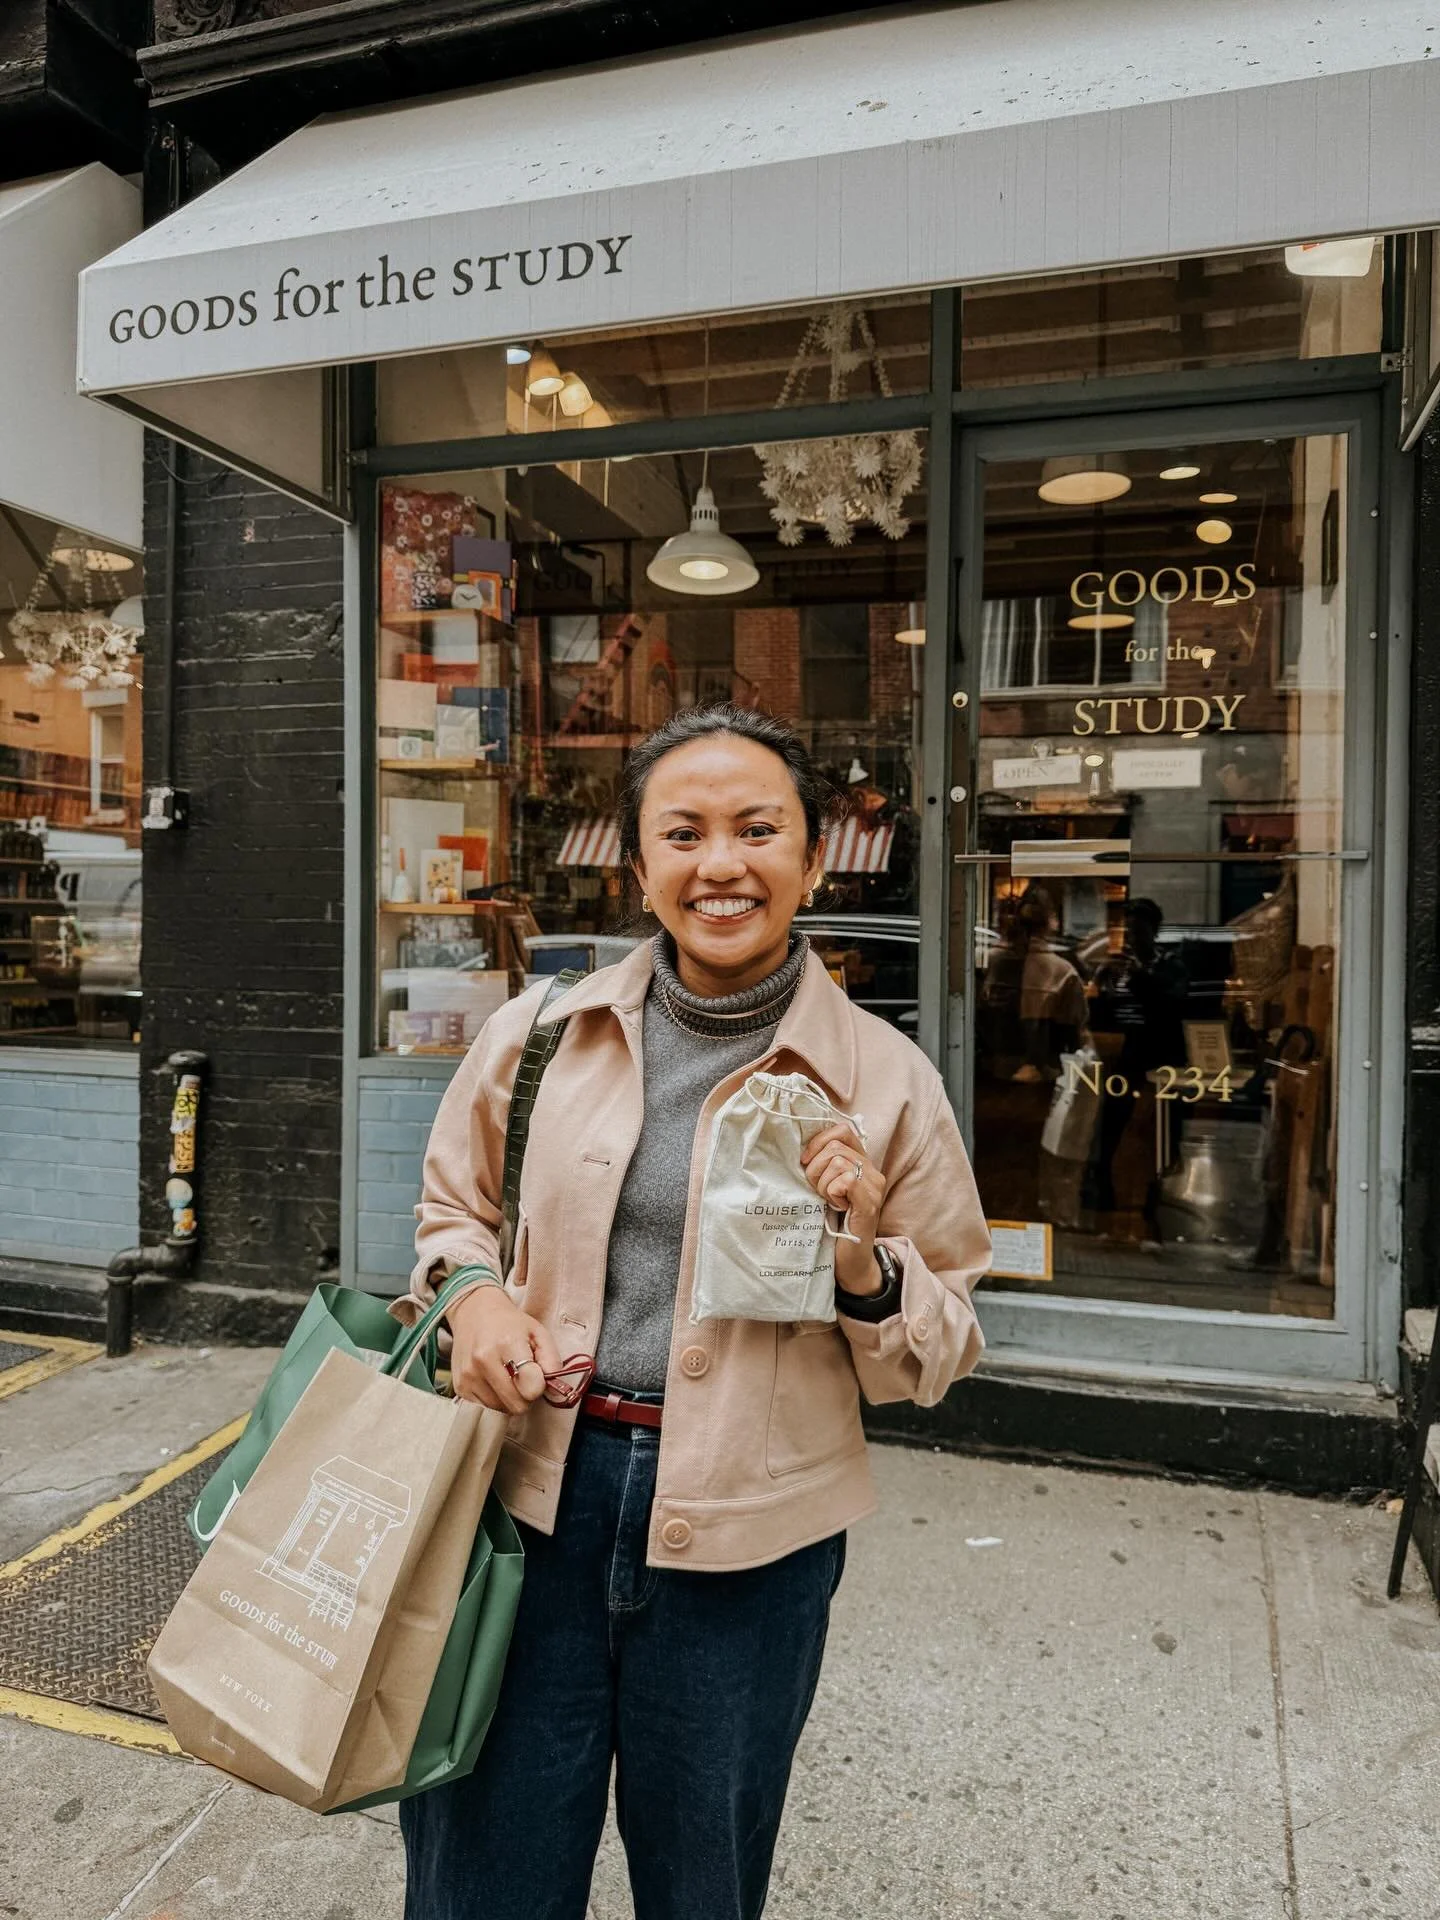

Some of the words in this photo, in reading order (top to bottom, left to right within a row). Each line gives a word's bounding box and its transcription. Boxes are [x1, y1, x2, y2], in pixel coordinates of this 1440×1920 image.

[109, 290, 257, 344] GOODS
[273, 267, 345, 321] for
[357, 255, 437, 309] the
[452, 234, 633, 296] STUDY
[1070, 563, 1256, 609] GOODS
[1125, 640, 1158, 662] for
[1166, 638, 1203, 661] the
[1072, 694, 1246, 736] STUDY
[1062, 1060, 1141, 1098] No.
[1155, 1064, 1233, 1102] 234
[745, 1205, 799, 1215] LOUISE
[775, 1237, 805, 1248] Paris,
[219, 1590, 266, 1623] GOODS
[264, 1612, 284, 1635] for
[284, 1624, 305, 1648] the
